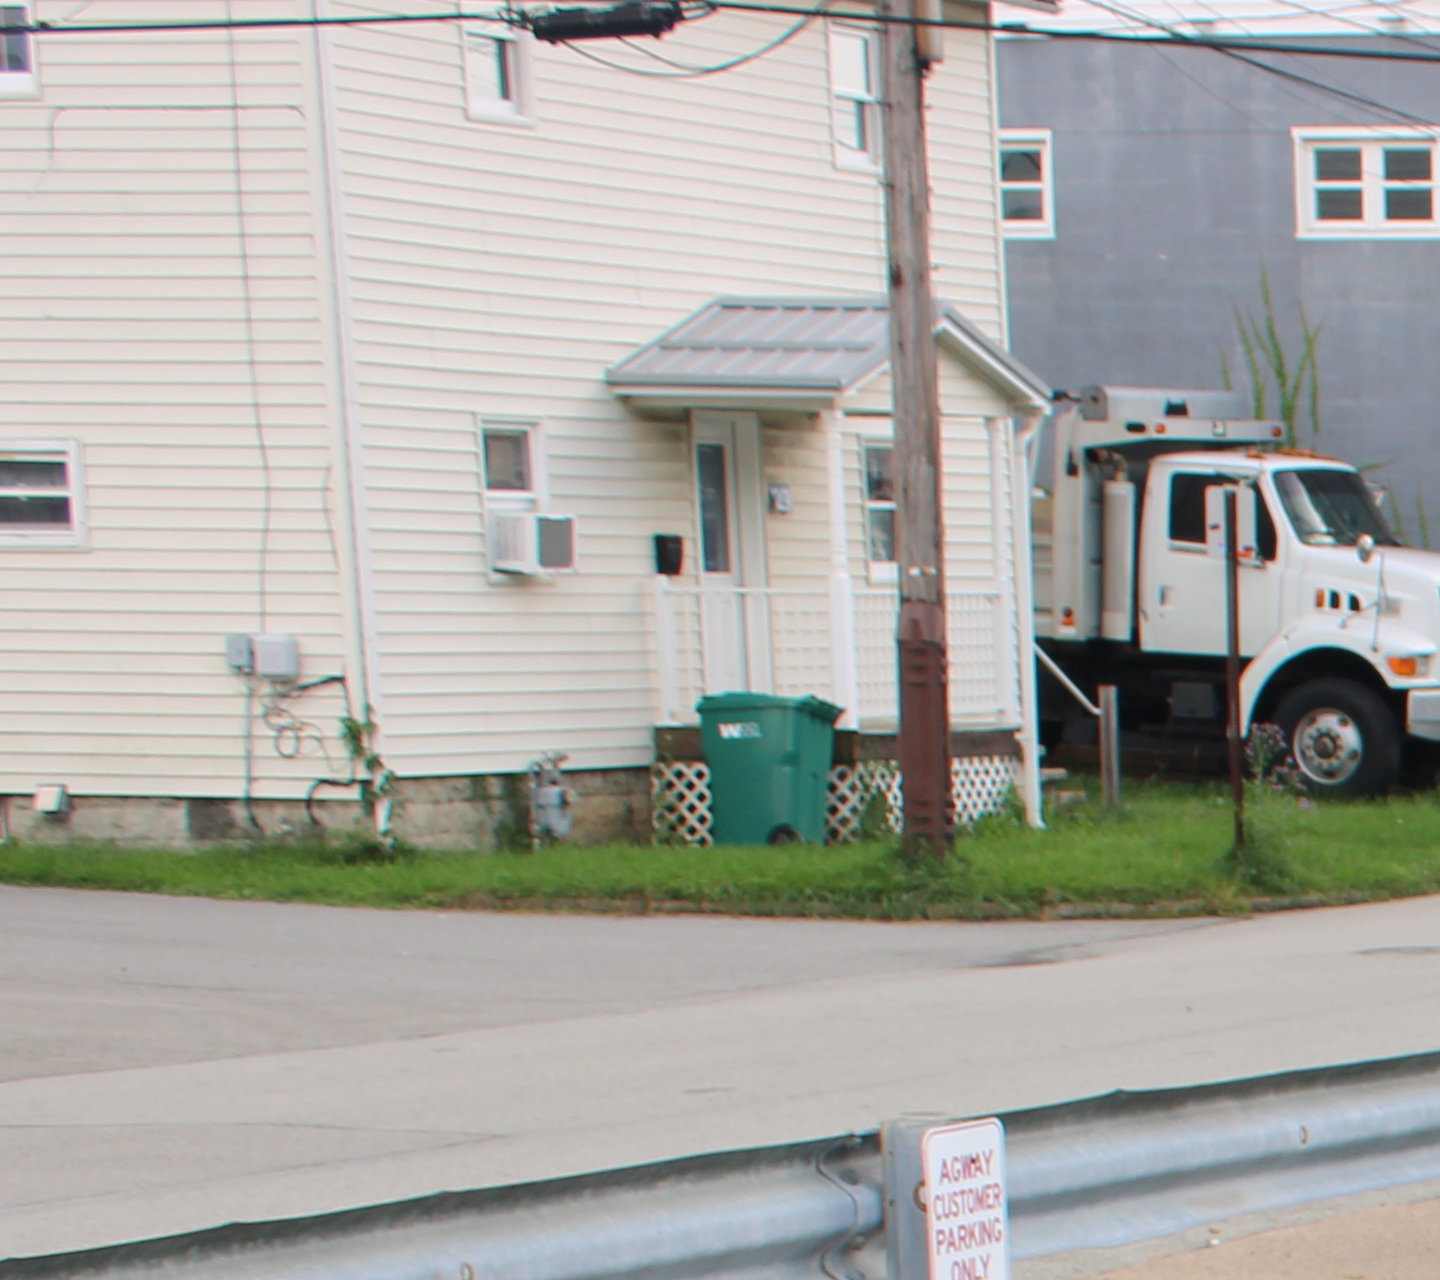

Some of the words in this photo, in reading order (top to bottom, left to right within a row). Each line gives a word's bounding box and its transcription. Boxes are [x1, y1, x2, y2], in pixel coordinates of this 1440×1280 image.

[940, 1149, 993, 1184] AGWAY
[933, 1183, 1003, 1221] CUSTOMER
[935, 1217, 1002, 1255] PARKING
